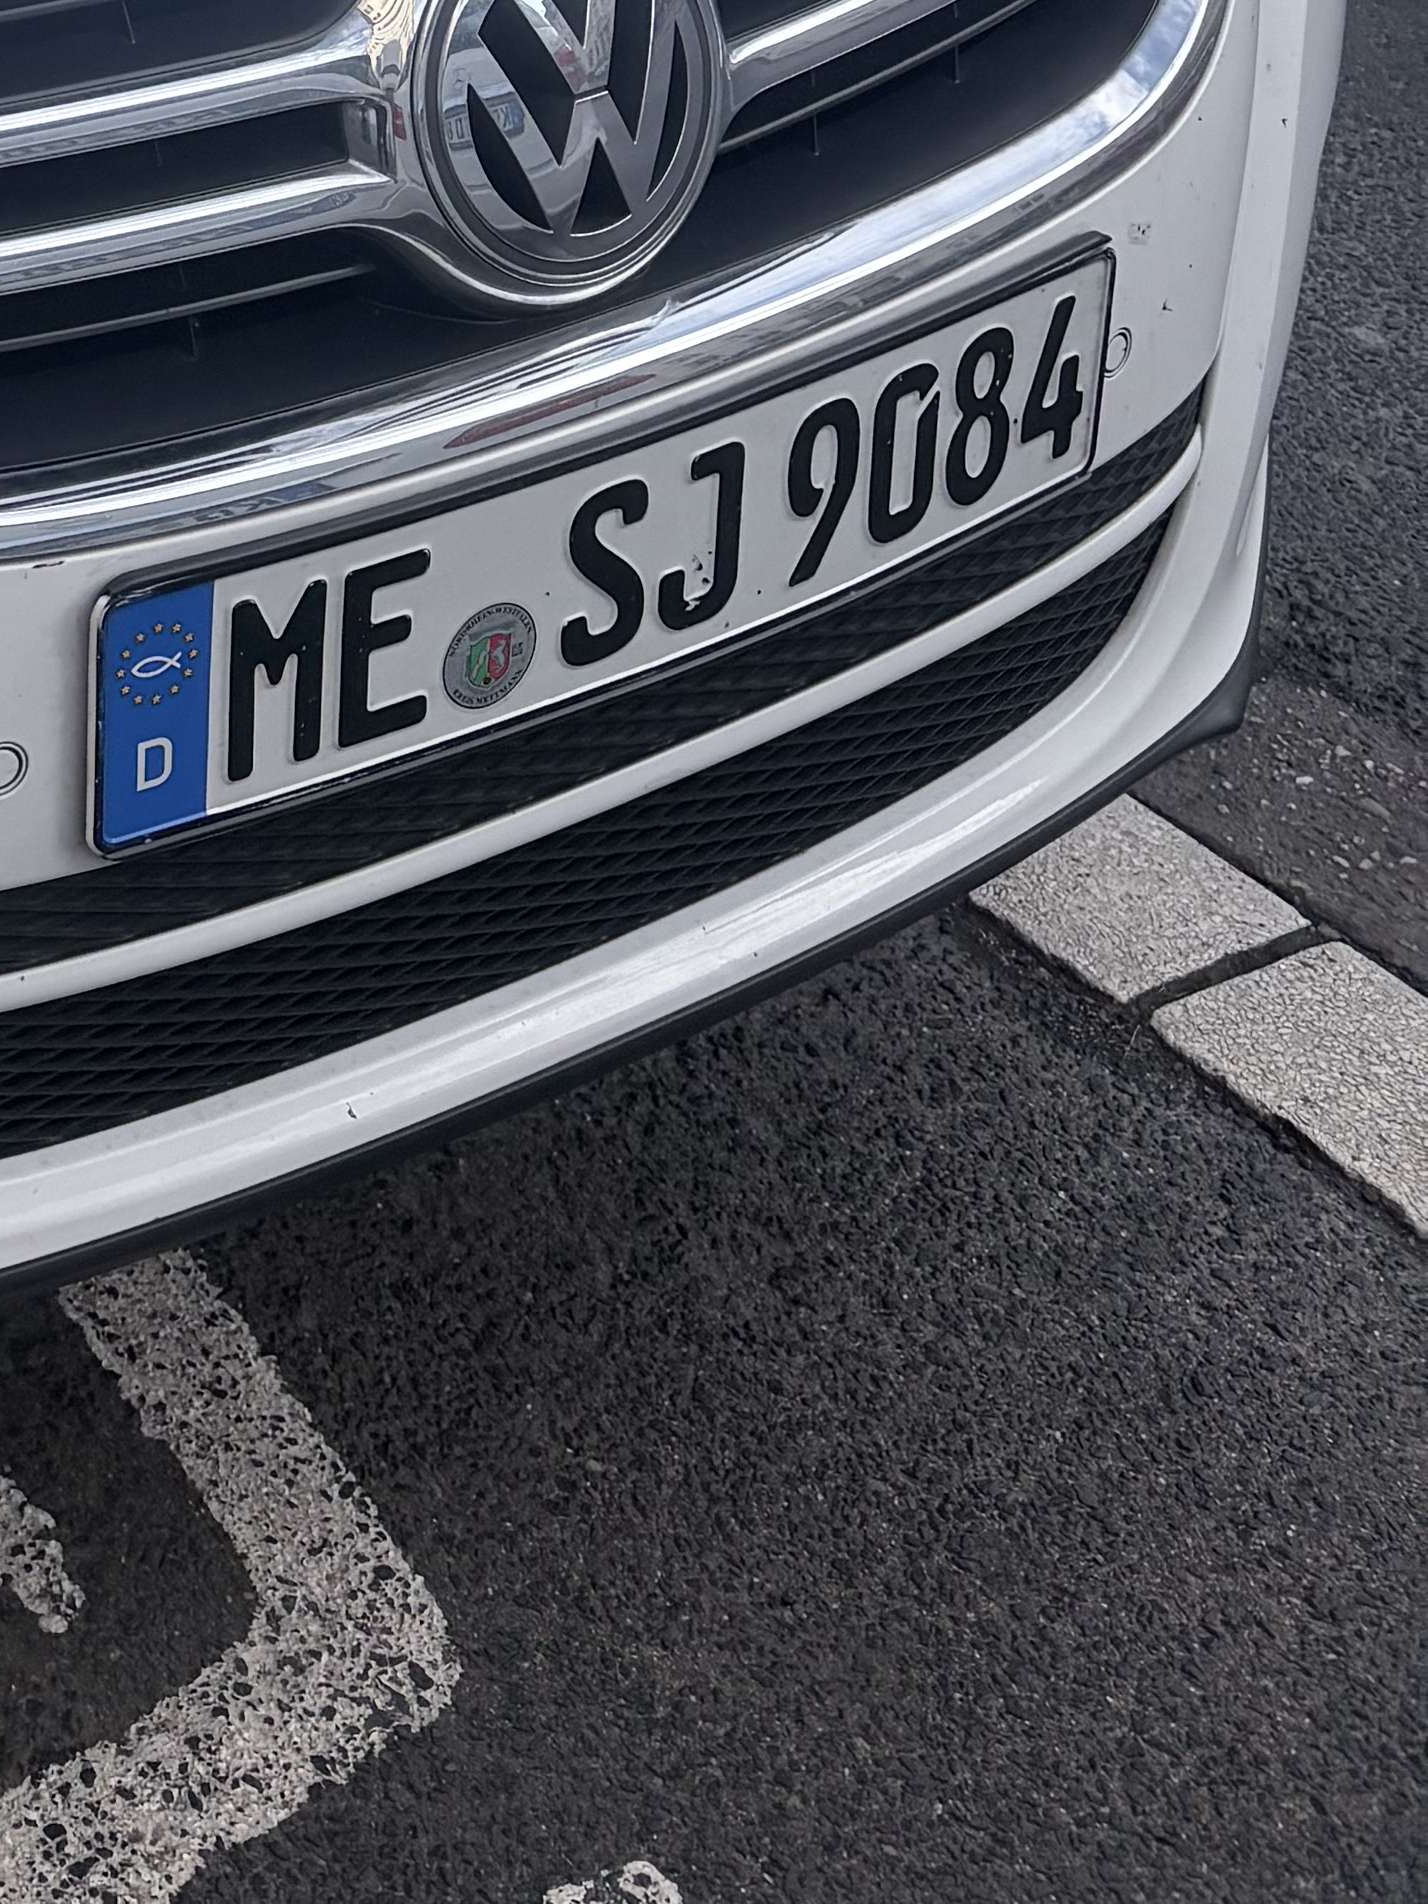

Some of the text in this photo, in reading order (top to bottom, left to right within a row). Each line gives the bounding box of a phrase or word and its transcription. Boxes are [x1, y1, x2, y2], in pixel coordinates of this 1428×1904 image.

[225, 294, 1087, 784] ME SJ 9084
[135, 736, 174, 793] D
